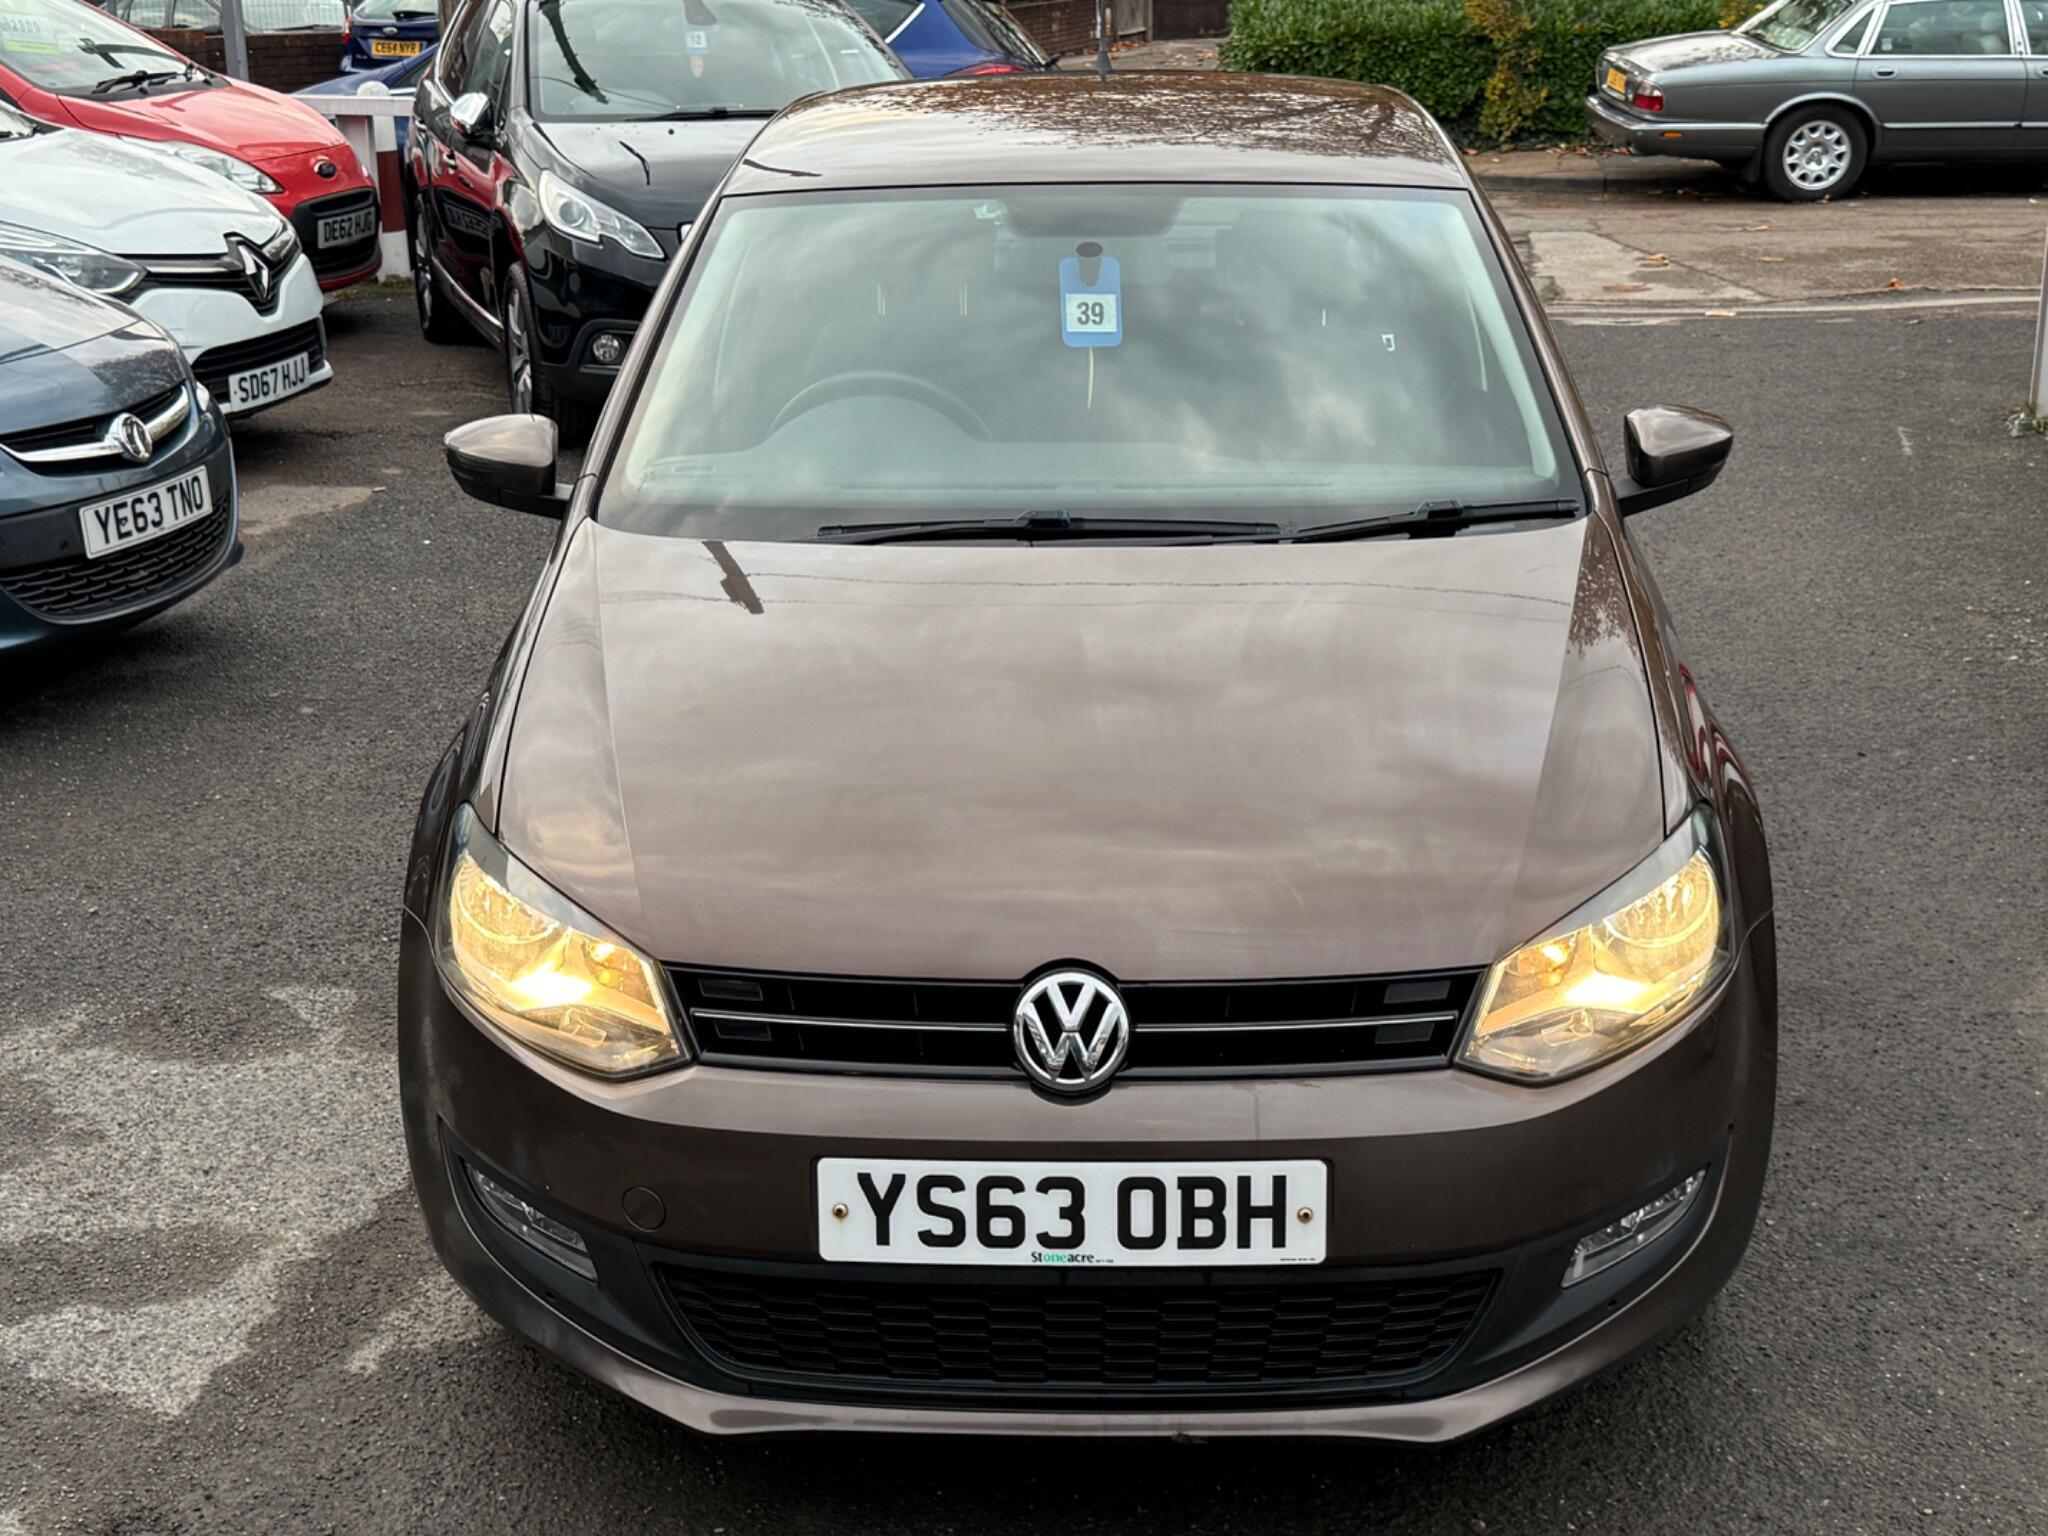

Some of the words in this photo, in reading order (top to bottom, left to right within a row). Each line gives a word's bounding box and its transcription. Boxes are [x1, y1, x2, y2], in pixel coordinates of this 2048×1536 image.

[324, 217, 353, 243] DE62
[1077, 301, 1105, 325] 39
[238, 367, 278, 403] SD67
[281, 357, 306, 392] HJJ
[94, 491, 164, 545] YE63
[166, 475, 204, 521] TNO
[857, 1172, 1087, 1250] YS63
[1116, 1175, 1287, 1250] OBH
[1031, 1251, 1095, 1264] Stoneacre
